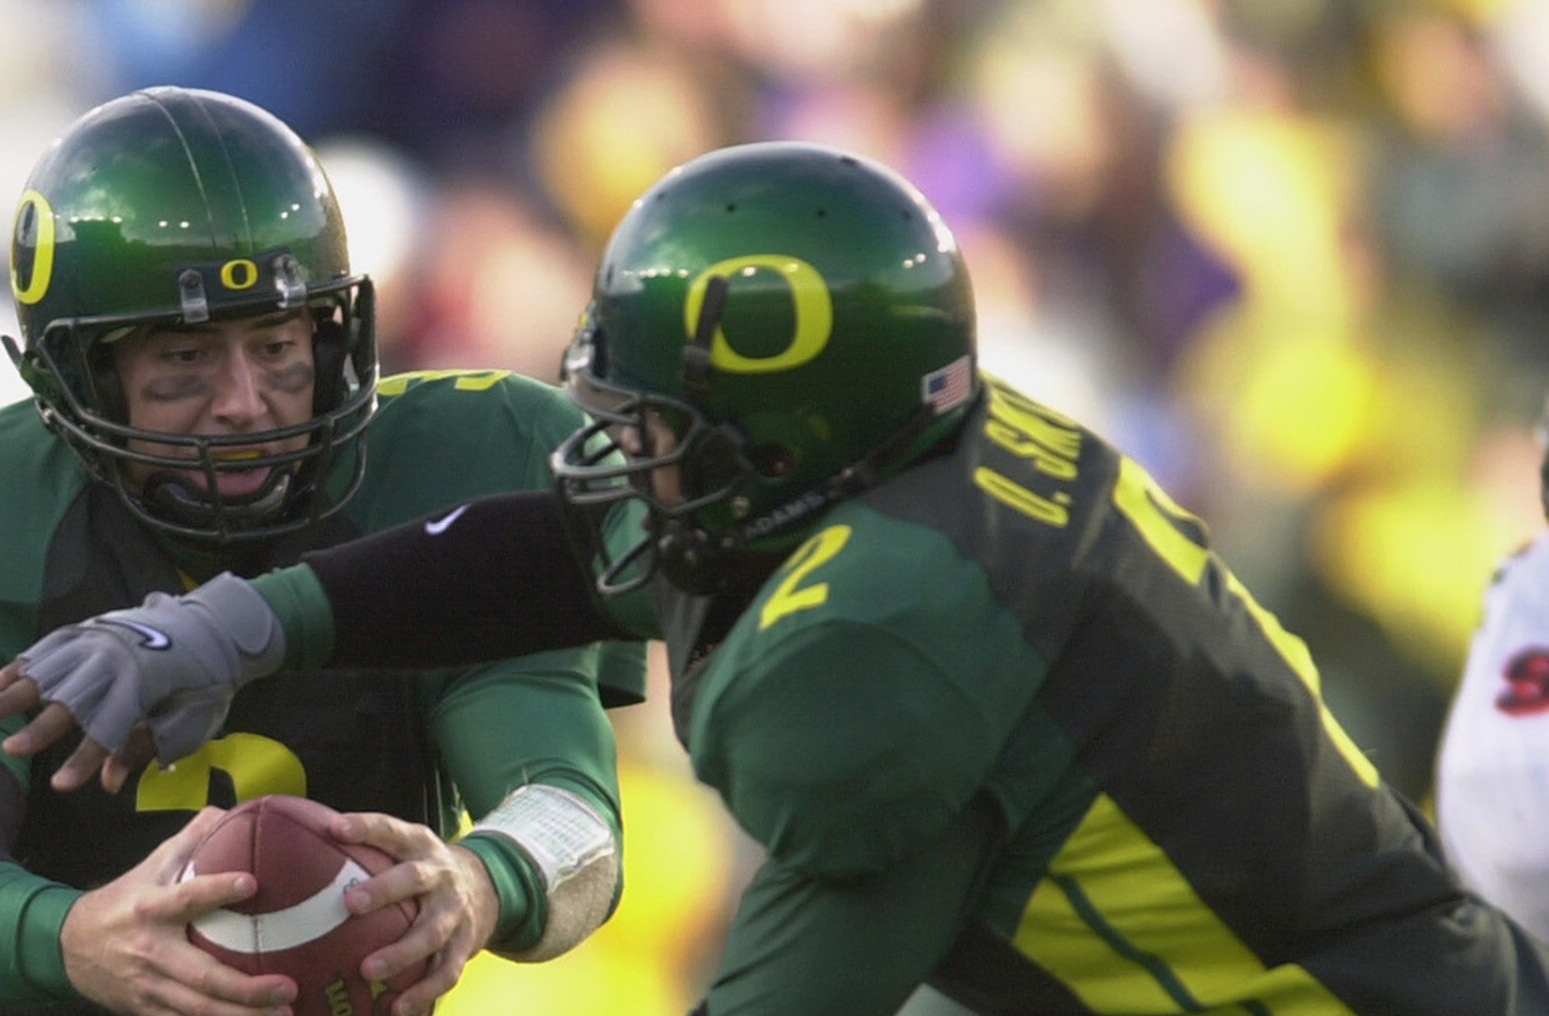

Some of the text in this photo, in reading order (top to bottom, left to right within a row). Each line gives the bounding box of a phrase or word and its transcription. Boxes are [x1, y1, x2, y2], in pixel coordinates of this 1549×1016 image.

[10, 189, 56, 305] O
[220, 258, 259, 290] O
[684, 253, 834, 375] O
[757, 523, 853, 632] 2
